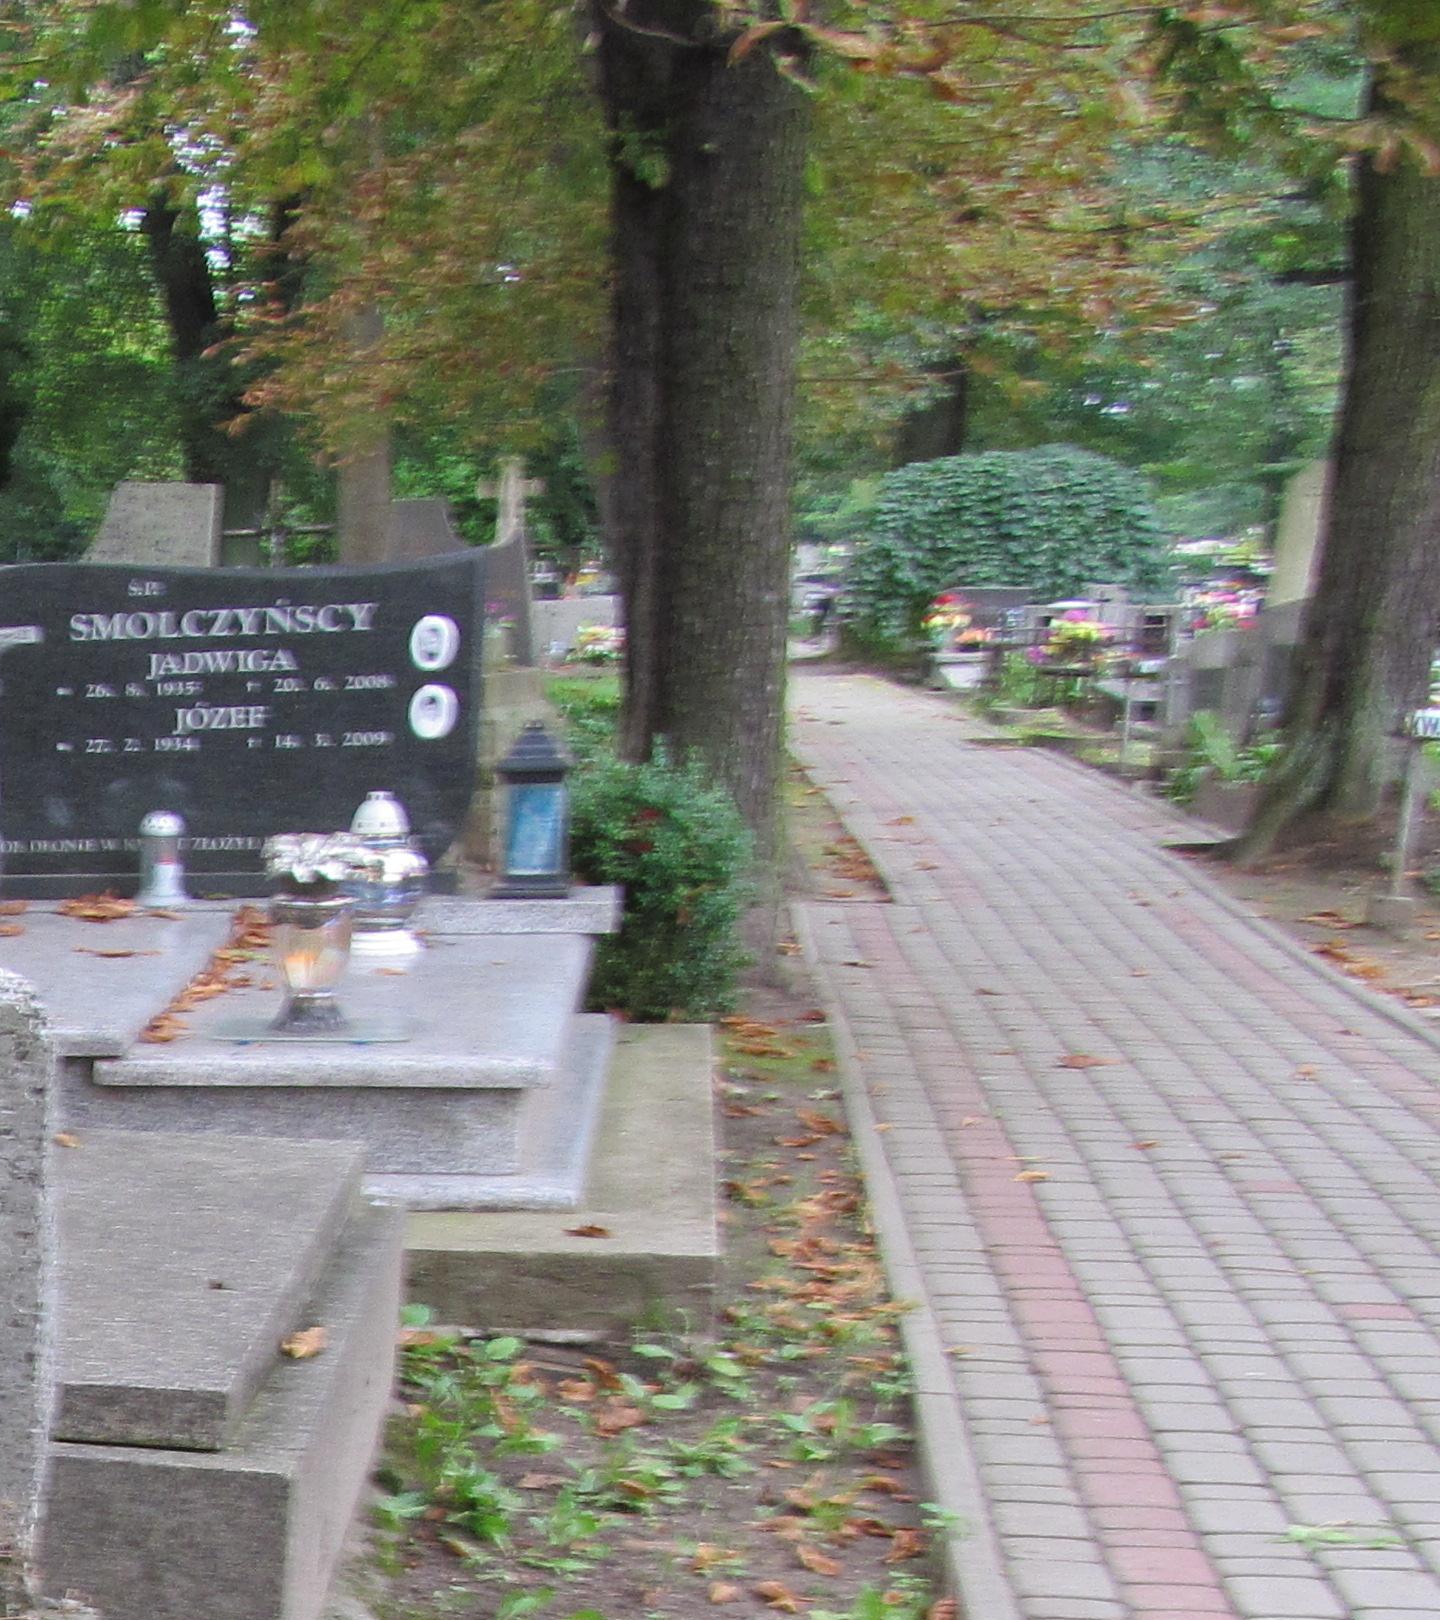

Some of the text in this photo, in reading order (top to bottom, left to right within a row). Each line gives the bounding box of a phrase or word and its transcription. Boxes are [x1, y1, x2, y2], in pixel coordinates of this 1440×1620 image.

[70, 598, 380, 642] SMOLCZYŃSCY
[146, 648, 300, 681] JADWIGA
[172, 701, 270, 735] JÓZEF
